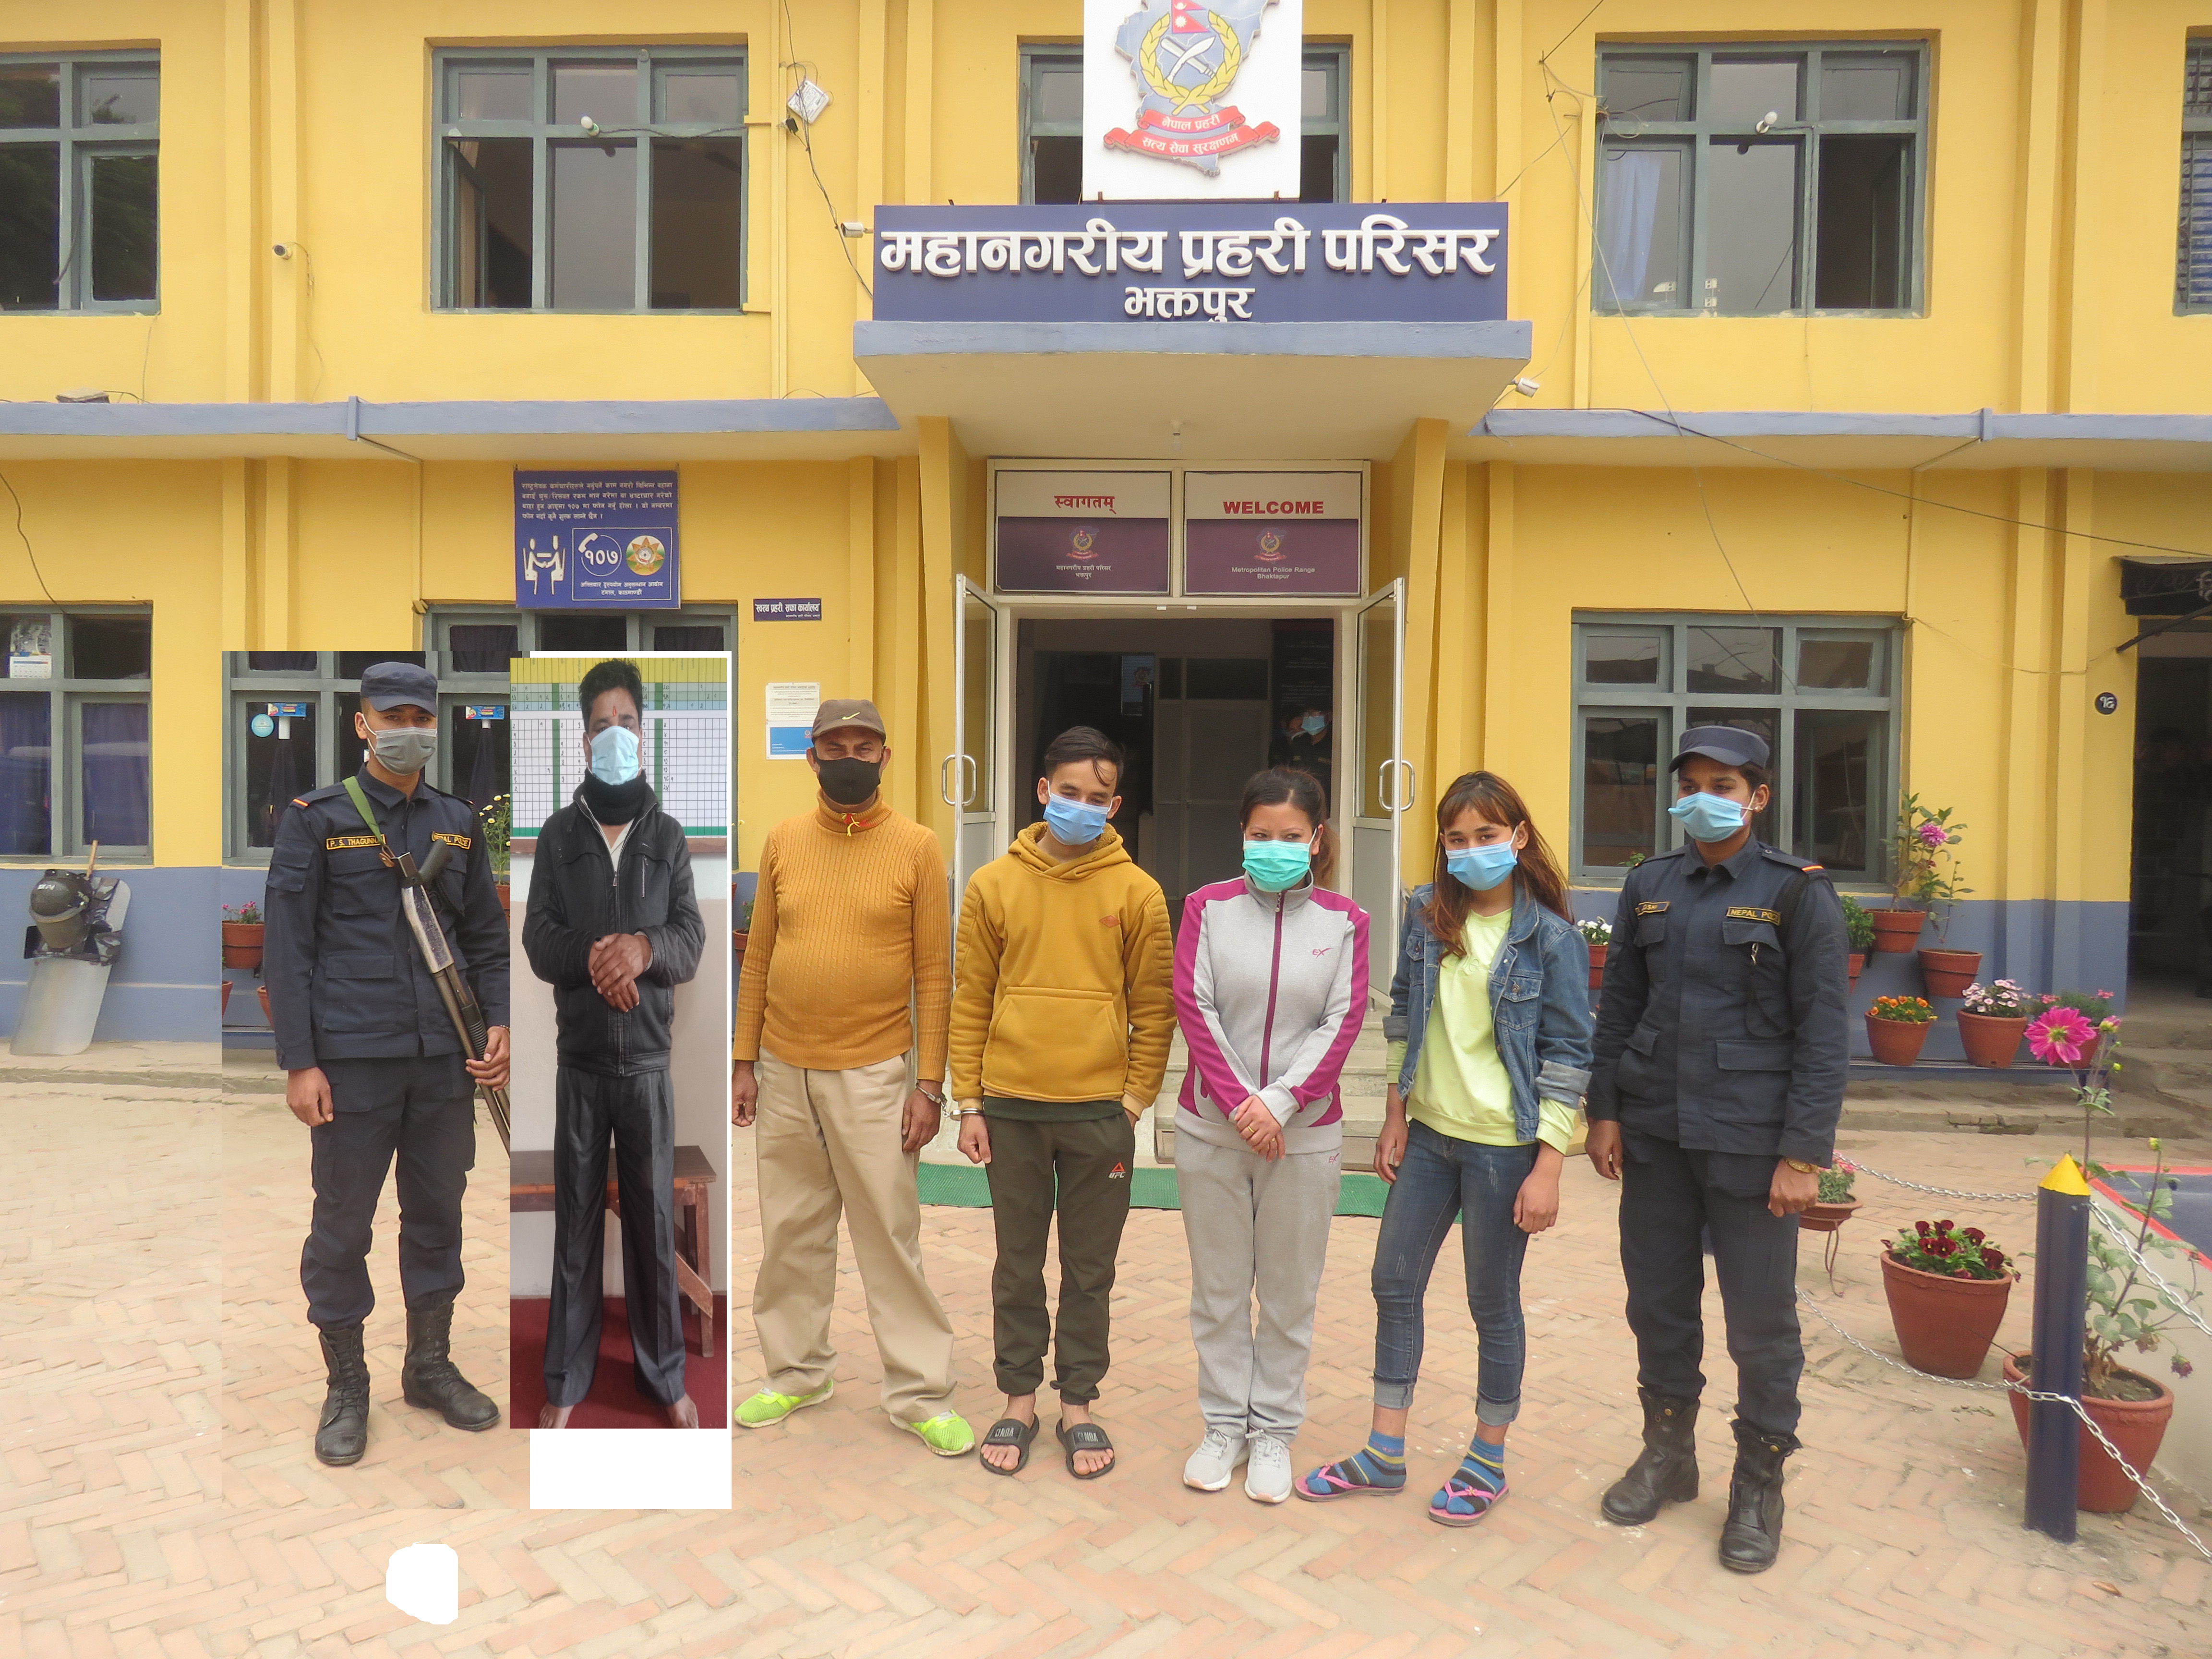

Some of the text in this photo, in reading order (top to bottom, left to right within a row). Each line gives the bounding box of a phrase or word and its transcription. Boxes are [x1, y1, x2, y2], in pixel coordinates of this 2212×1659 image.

[1162, 115, 1221, 131] नेपाल प्रहरी
[1142, 136, 1166, 151] सत्य
[1169, 142, 1189, 154] सेवा
[881, 214, 1500, 278] महानगरीय प्रहरी परिसर
[1124, 288, 1256, 321] भक्तपुर
[1054, 495, 1116, 514] स्वागतम्
[1224, 501, 1324, 514] WELCOME
[585, 550, 619, 565] १०७
[770, 601, 783, 613] प्रहरी
[798, 602, 820, 612] कार्यालय
[1731, 909, 1757, 917] NEPAL
[1000, 1427, 1014, 1437] NBA
[1084, 1432, 1099, 1443] NBA
